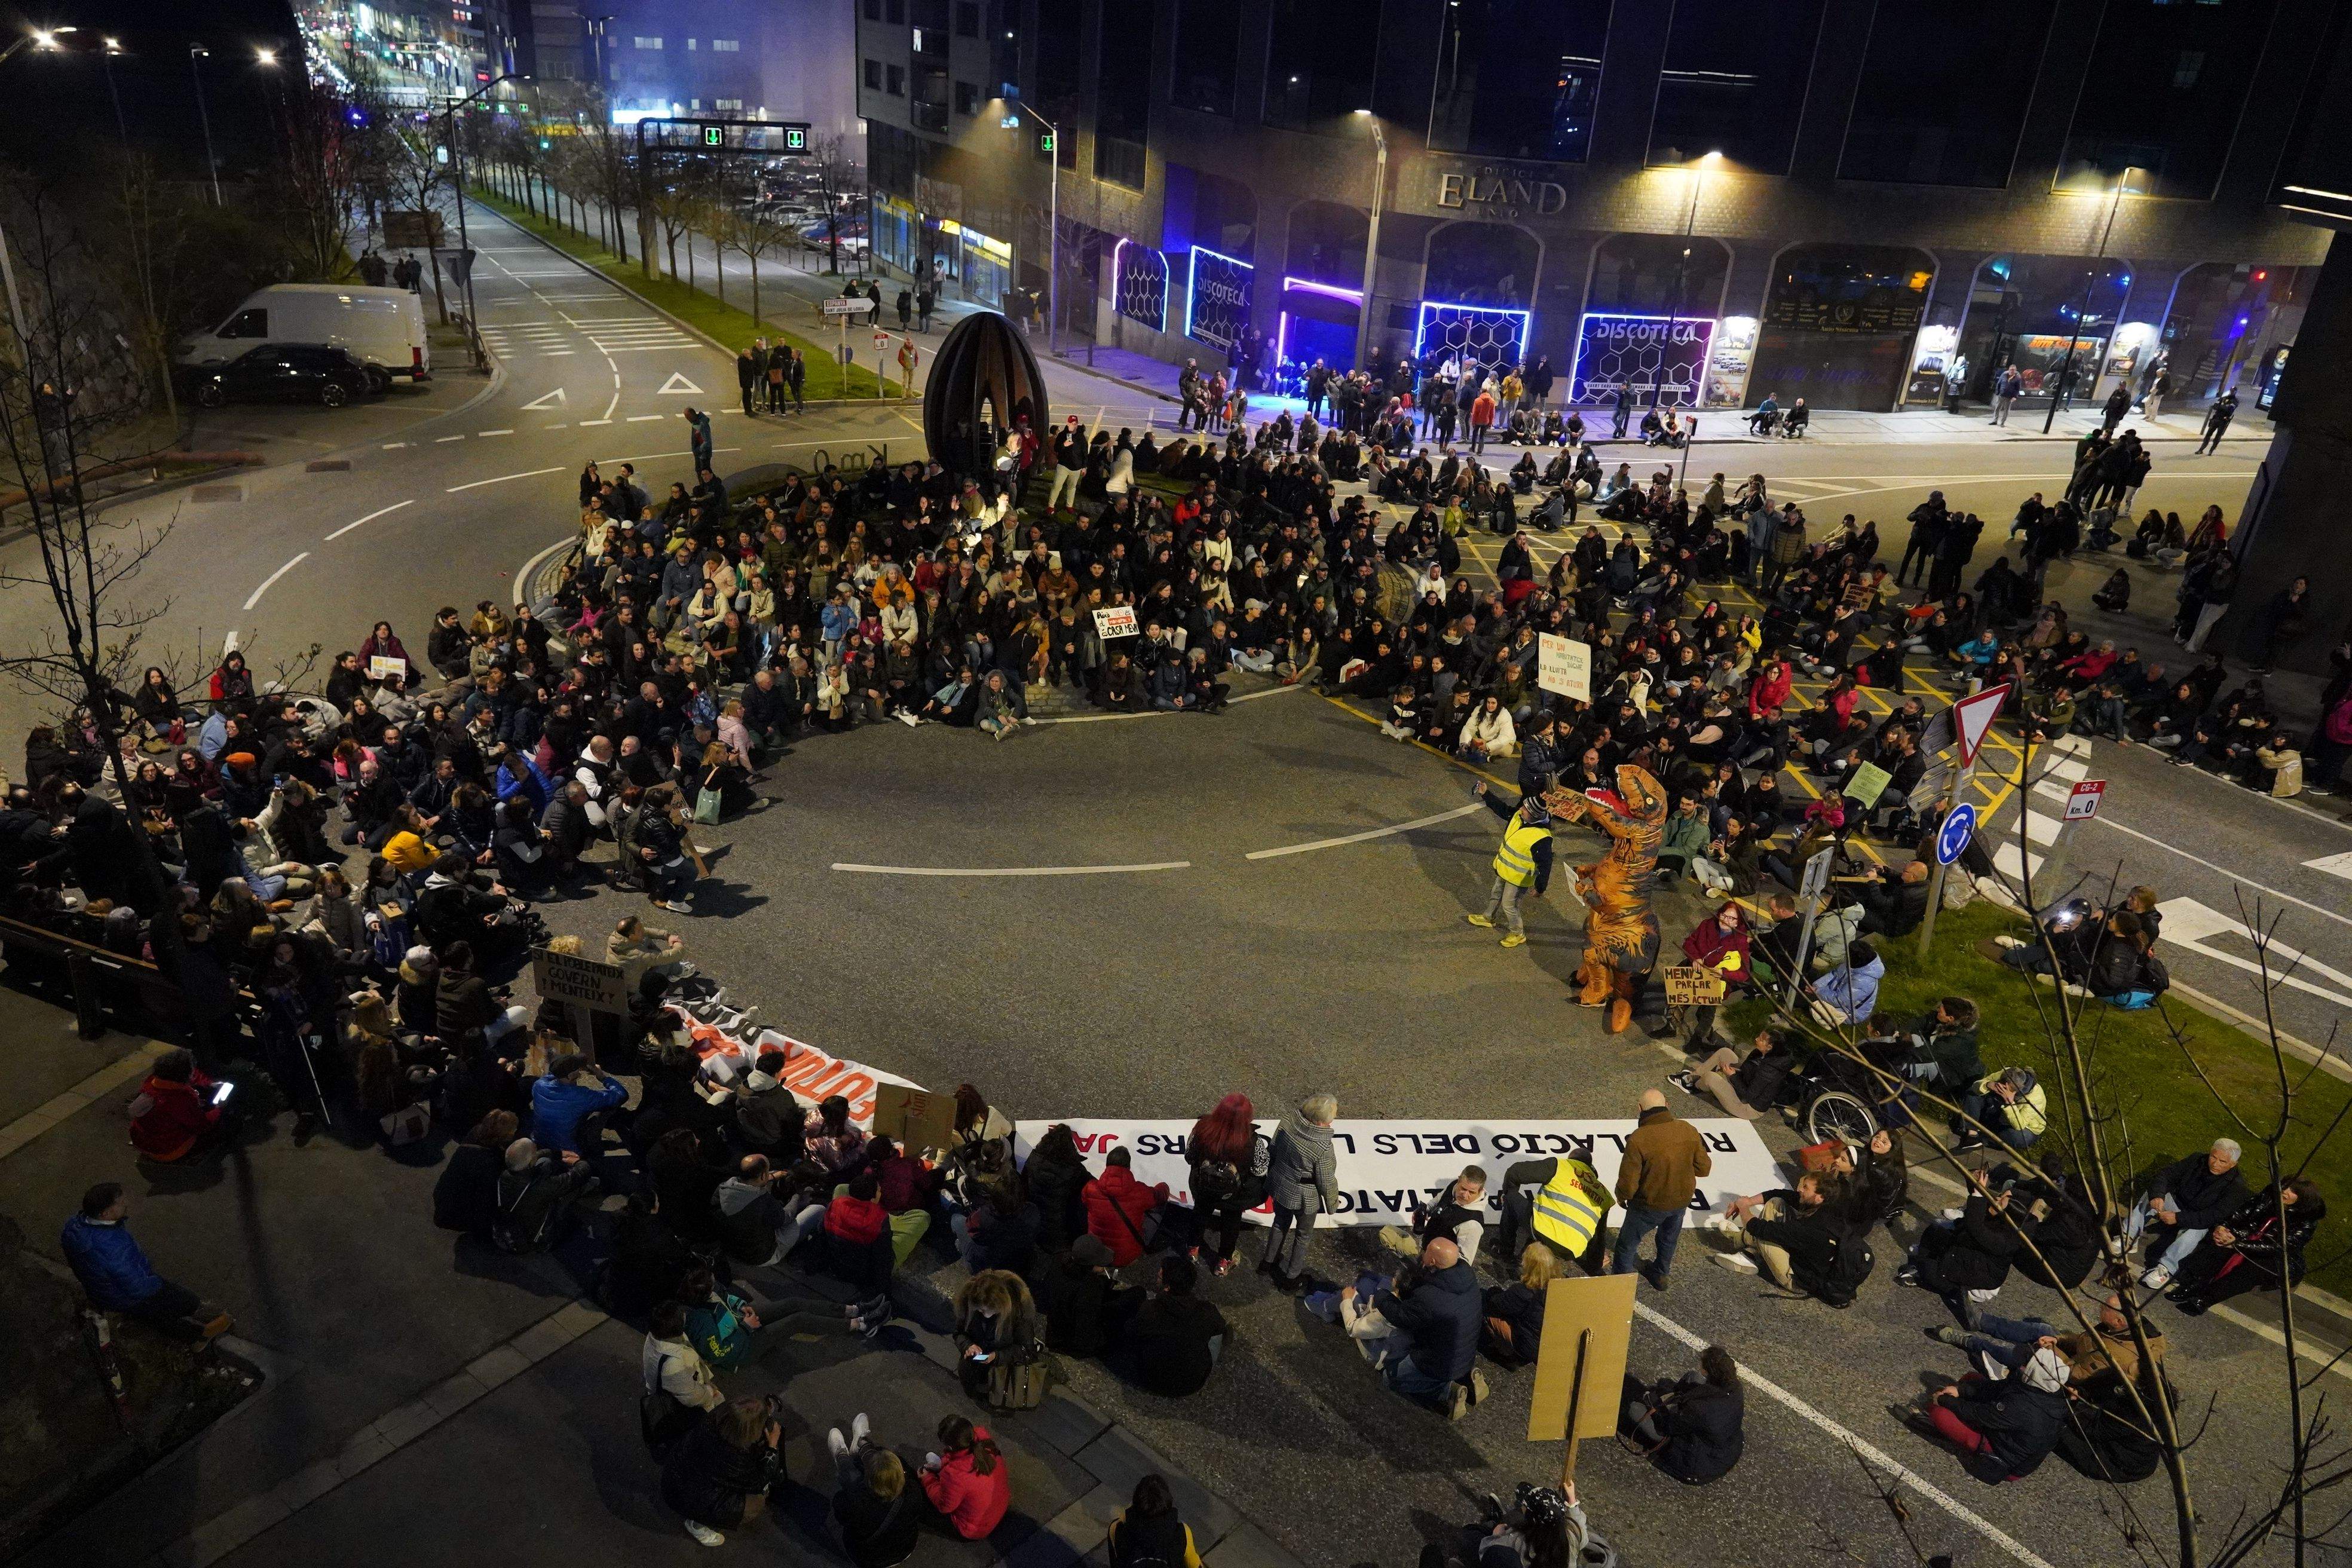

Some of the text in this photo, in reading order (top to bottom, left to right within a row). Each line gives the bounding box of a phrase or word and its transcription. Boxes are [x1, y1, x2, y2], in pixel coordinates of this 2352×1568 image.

[1437, 173, 1566, 214] ELAND
[1198, 278, 1244, 306] DISCOTECA
[1597, 323, 1694, 341] DISCOTECA
[1107, 625, 1124, 636] CASA
[1542, 638, 1566, 652] PER UN
[1549, 664, 1567, 675] LLUITA
[1567, 662, 1583, 671] DIGNE
[1548, 675, 1555, 684] NO
[2080, 783, 2099, 792] CG-2
[2085, 800, 2094, 813] 0
[547, 953, 562, 965] EL
[548, 966, 601, 990] GOVERN
[1676, 981, 1711, 989] PARLAR
[1668, 992, 1722, 1004] MÉS ACTUAR
[1374, 1134, 1481, 1154] DELS
